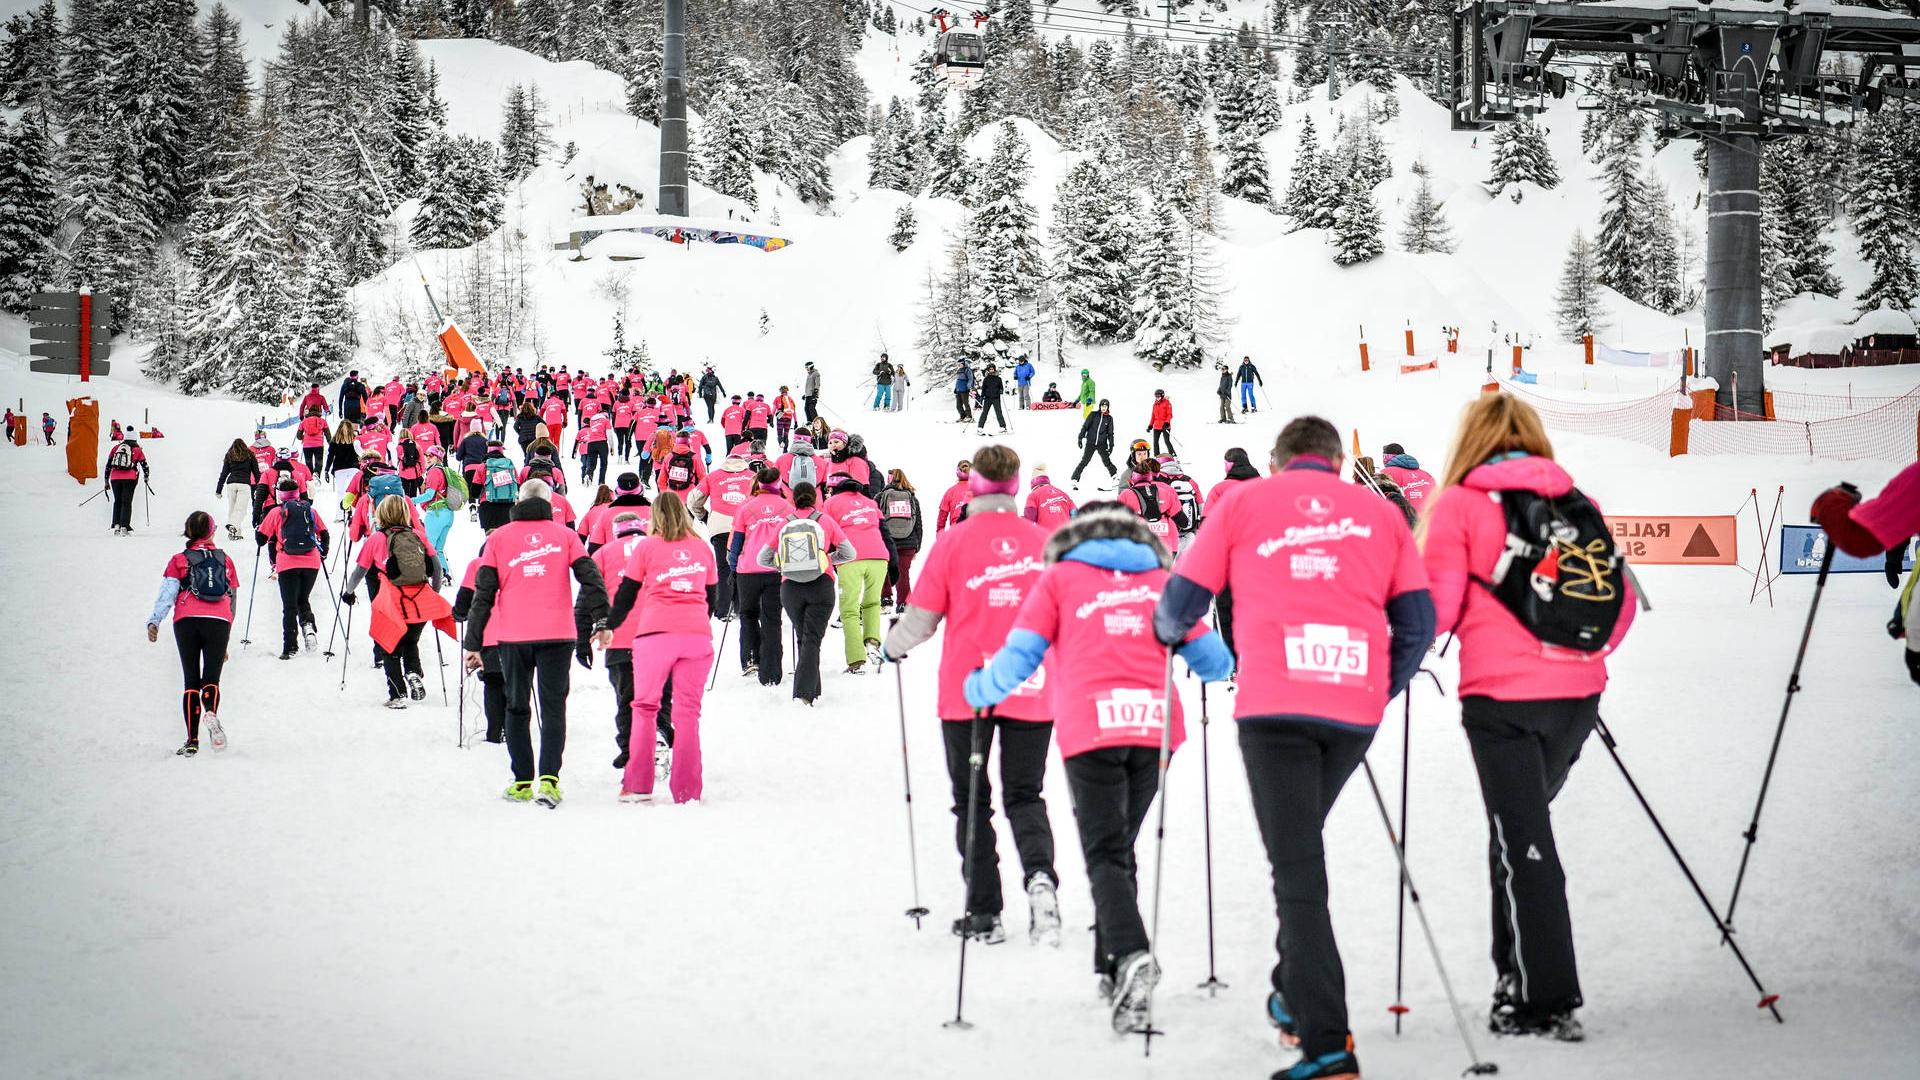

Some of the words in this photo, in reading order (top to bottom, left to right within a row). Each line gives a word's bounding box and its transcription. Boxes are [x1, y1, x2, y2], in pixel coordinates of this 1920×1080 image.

[1805, 558, 1823, 568] Plag
[1296, 644, 1360, 670] 1075
[1106, 703, 1165, 723] 1074
